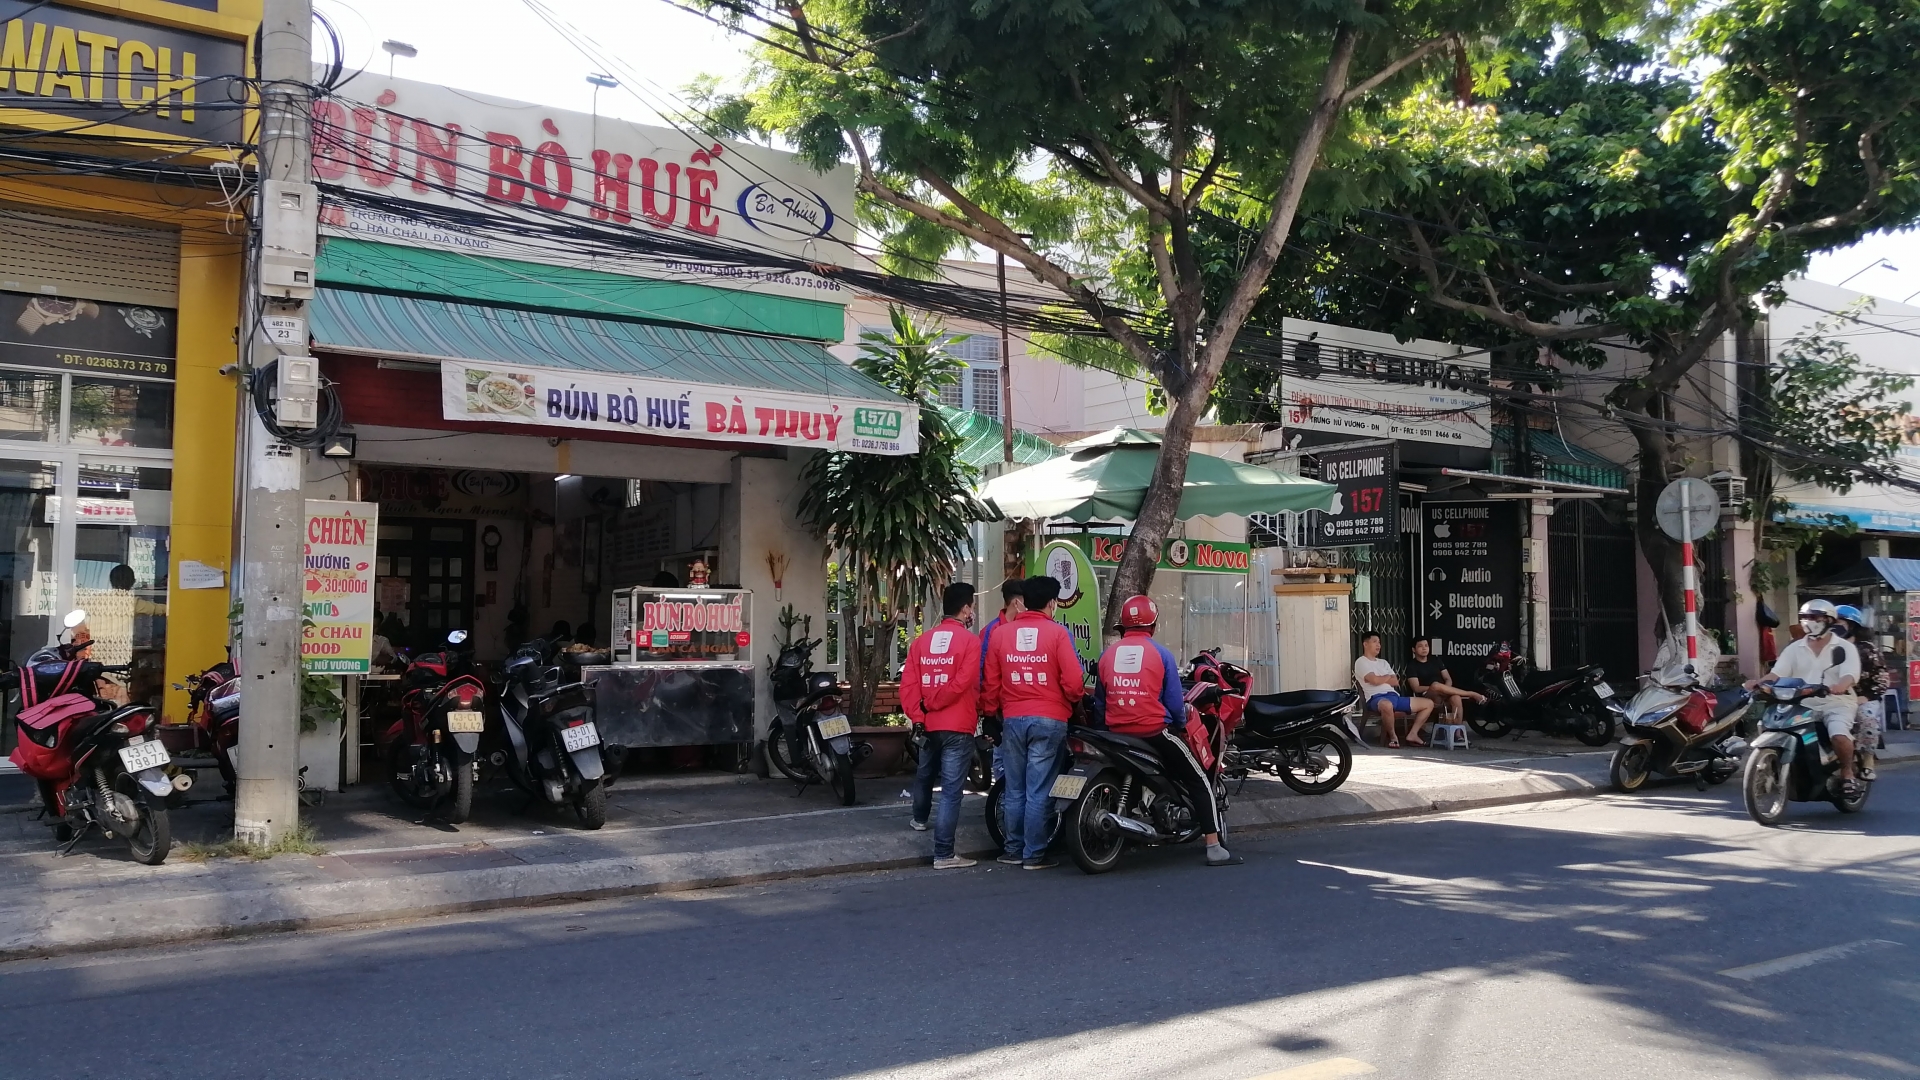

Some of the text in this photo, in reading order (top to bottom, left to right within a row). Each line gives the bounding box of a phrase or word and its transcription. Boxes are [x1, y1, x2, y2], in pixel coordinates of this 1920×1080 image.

[0, 18, 196, 122] WATCH
[312, 88, 723, 237] BÚN BÒ HUẾ
[755, 193, 775, 215] Bà
[277, 330, 290, 338] 23
[64, 354, 168, 373] ĐT: 02363.73 73 79
[547, 383, 599, 421] BÚN
[607, 387, 638, 426] BÒ
[646, 391, 691, 430] HUẾ
[705, 395, 748, 435] BÀ
[859, 410, 897, 427] 157A
[1420, 429, 1432, 437] 0511
[1326, 456, 1385, 481] US CELLPHONE
[1350, 487, 1384, 513] 157
[1400, 506, 1420, 534] BOOK
[1431, 507, 1489, 519] US CELLPHONE
[308, 510, 367, 545] CHIÊN
[1336, 517, 1384, 528] 0905 992 789
[1336, 526, 1384, 536] 0906 642 789
[305, 553, 350, 570] NƯỚNG
[1197, 543, 1249, 569] Nova
[1461, 567, 1491, 583] Audio
[1326, 599, 1337, 608] 157
[1449, 593, 1504, 608] Bluetooth
[643, 594, 682, 632] BÚN
[682, 596, 706, 632] BÒ
[706, 593, 744, 632] HUẾ
[1456, 614, 1496, 629] Device
[320, 625, 362, 639] CHÂU
[1073, 617, 1091, 651] mỳ
[1447, 640, 1493, 657] Accessor
[314, 660, 329, 670] NỮ
[330, 660, 361, 671] VƯƠNG
[1006, 653, 1047, 663] NowFood
[1113, 675, 1140, 688] Now
[454, 713, 477, 722] 43-C1
[452, 722, 481, 731] 434.42
[127, 743, 157, 759] 43-C1
[567, 734, 597, 751] 632.73
[127, 753, 167, 771] 798.72
